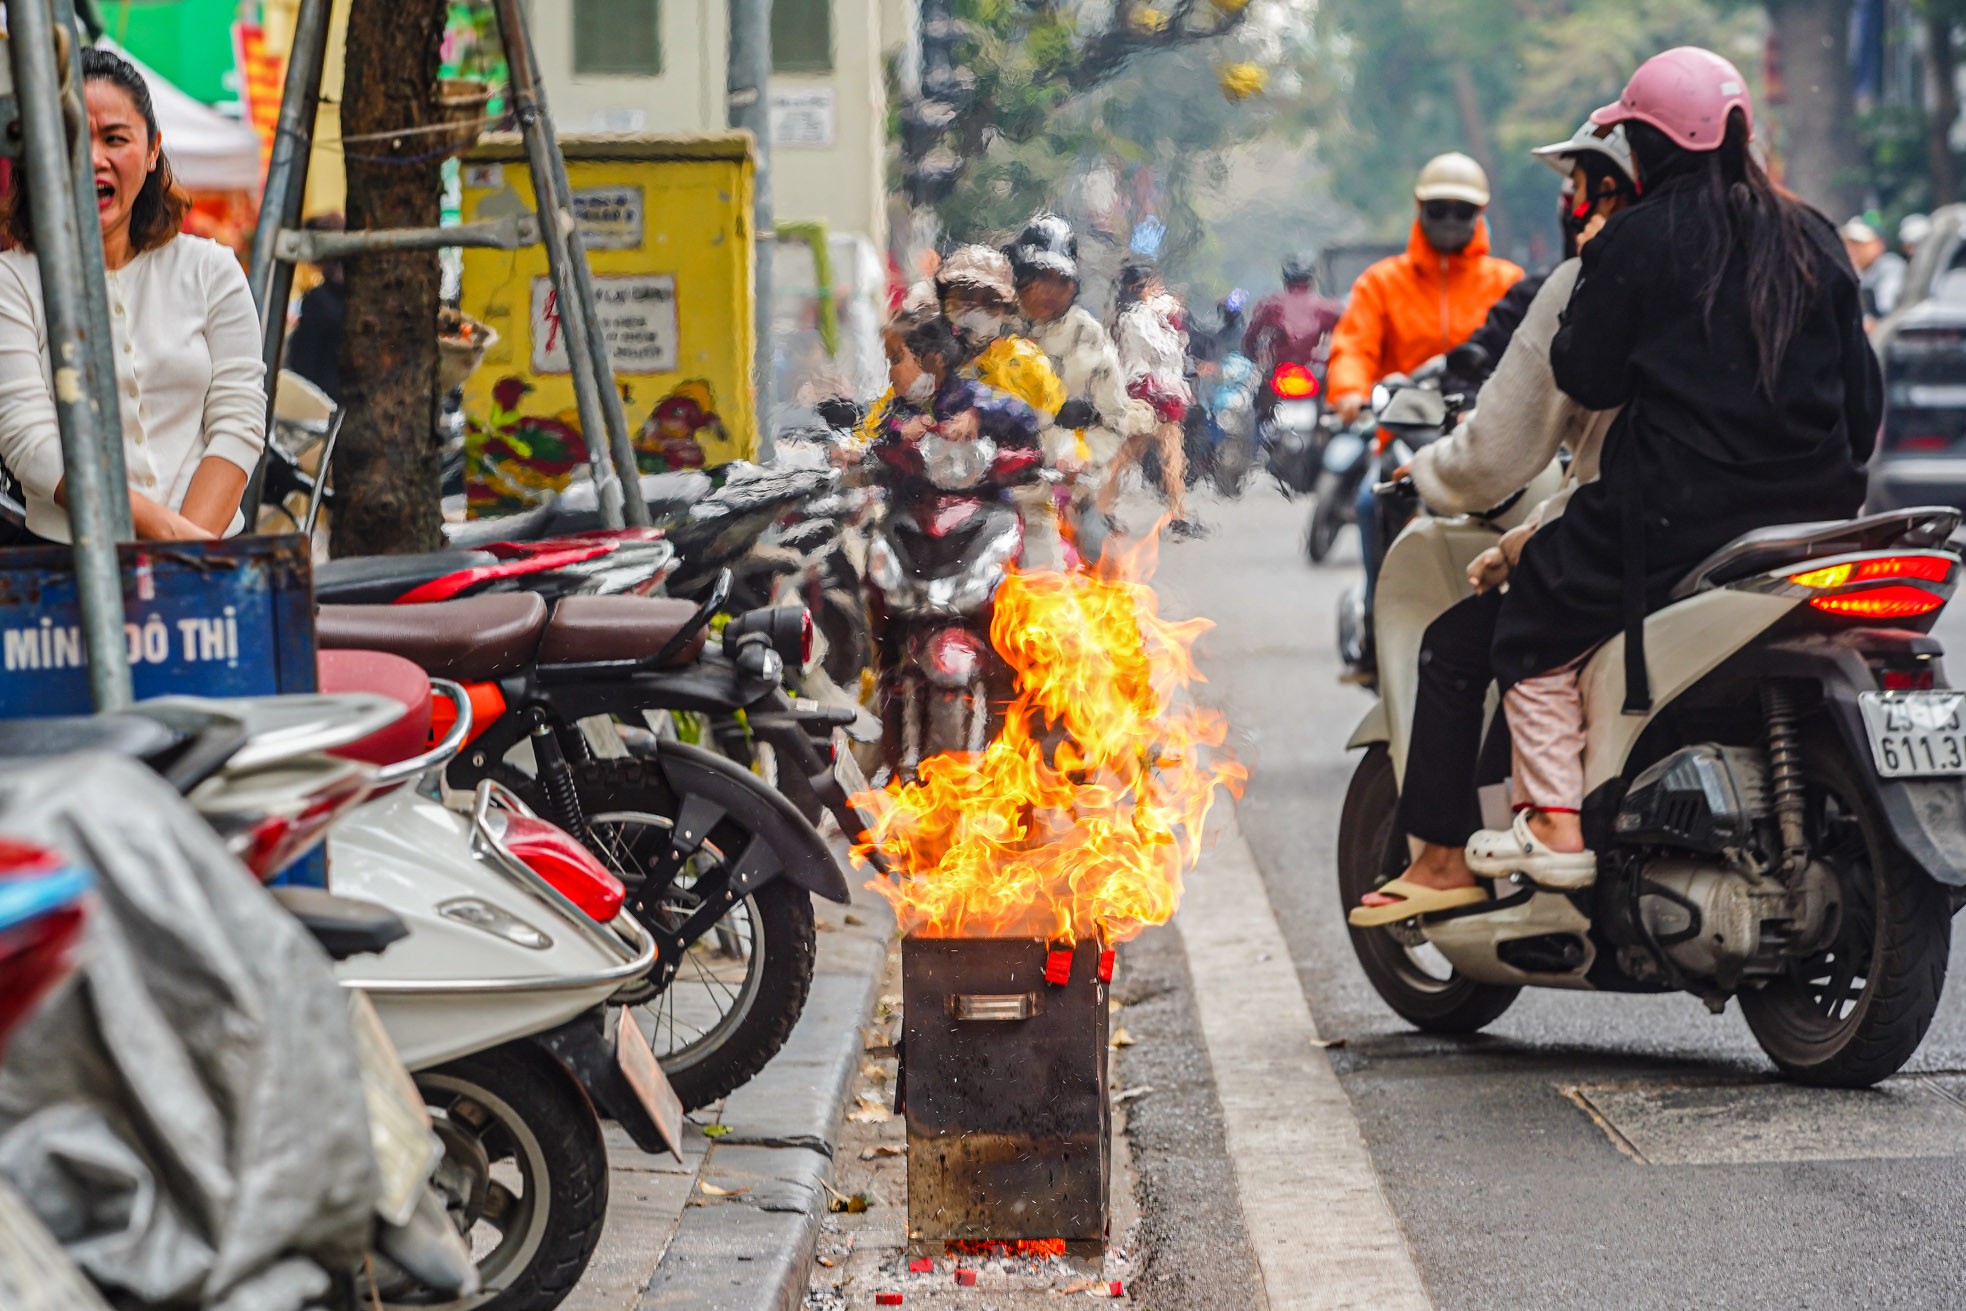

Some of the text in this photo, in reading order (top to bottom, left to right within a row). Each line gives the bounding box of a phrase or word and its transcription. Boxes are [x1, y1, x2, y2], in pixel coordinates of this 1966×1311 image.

[4, 616, 87, 671] MIN
[177, 605, 239, 669] THỊ
[1881, 735, 1966, 770] 611.3
